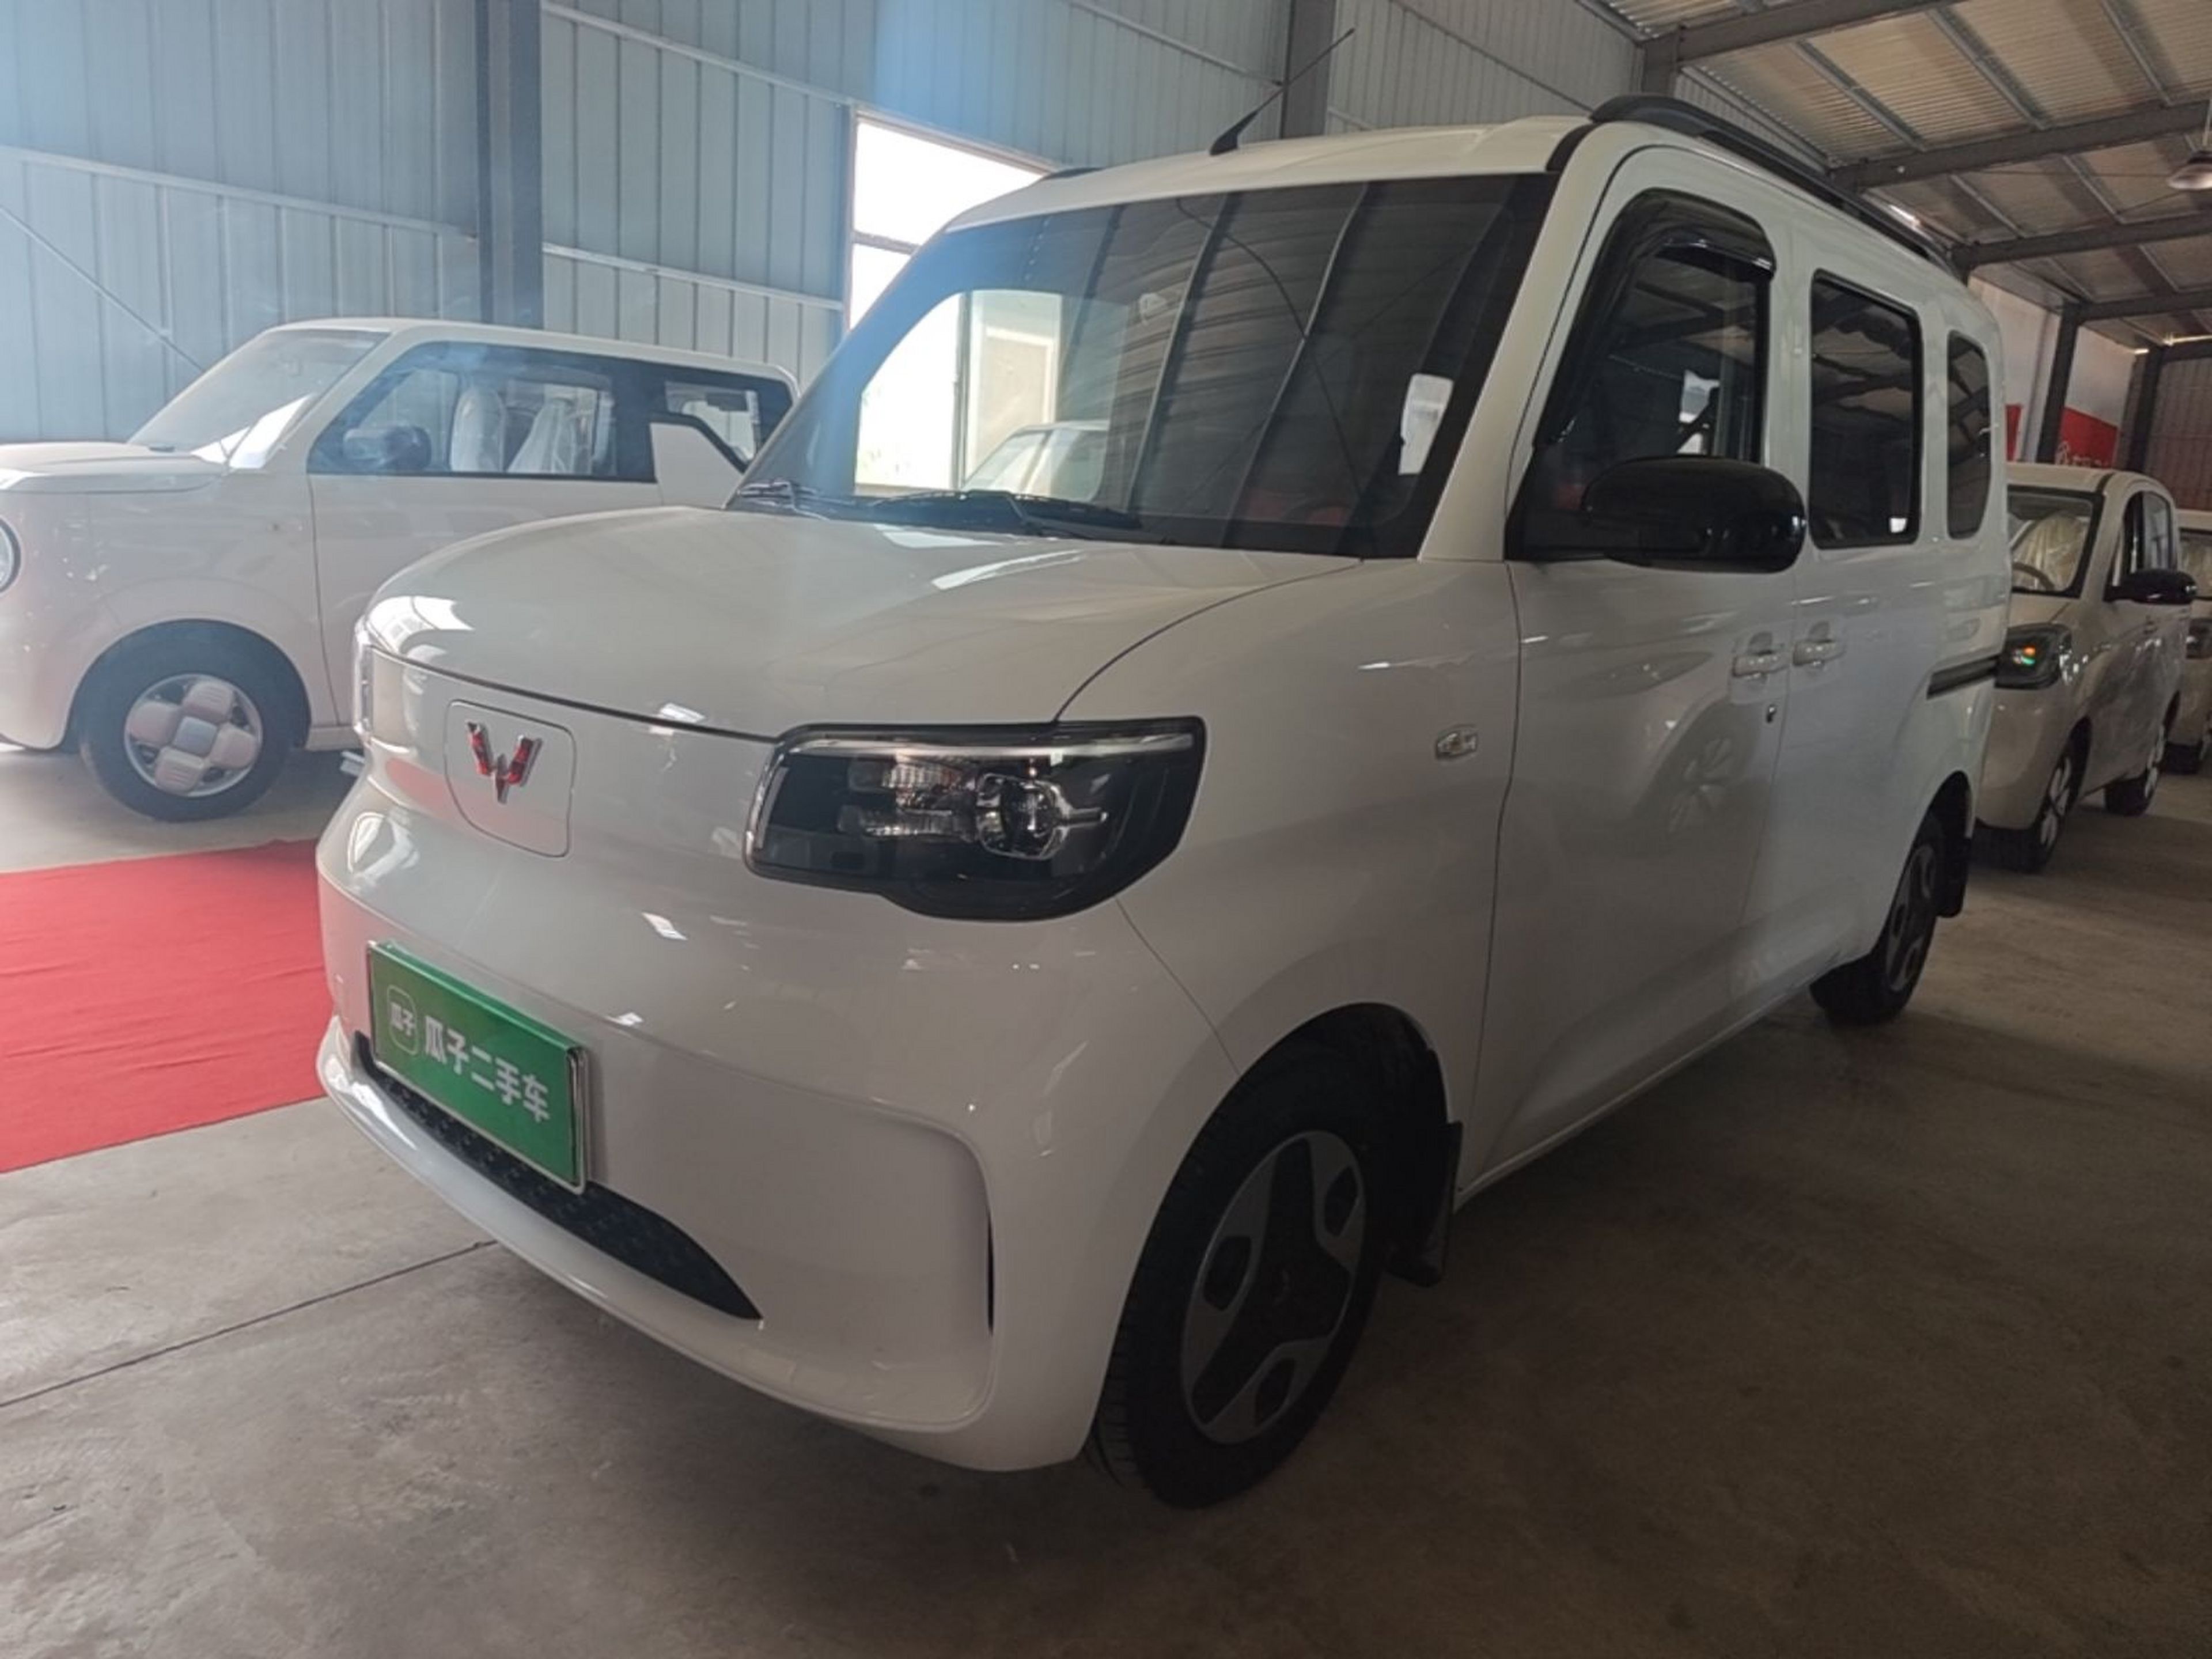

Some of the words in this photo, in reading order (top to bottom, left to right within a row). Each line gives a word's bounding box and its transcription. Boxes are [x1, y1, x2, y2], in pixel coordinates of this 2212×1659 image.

[425, 1014, 550, 1122] 瓜子二手车
